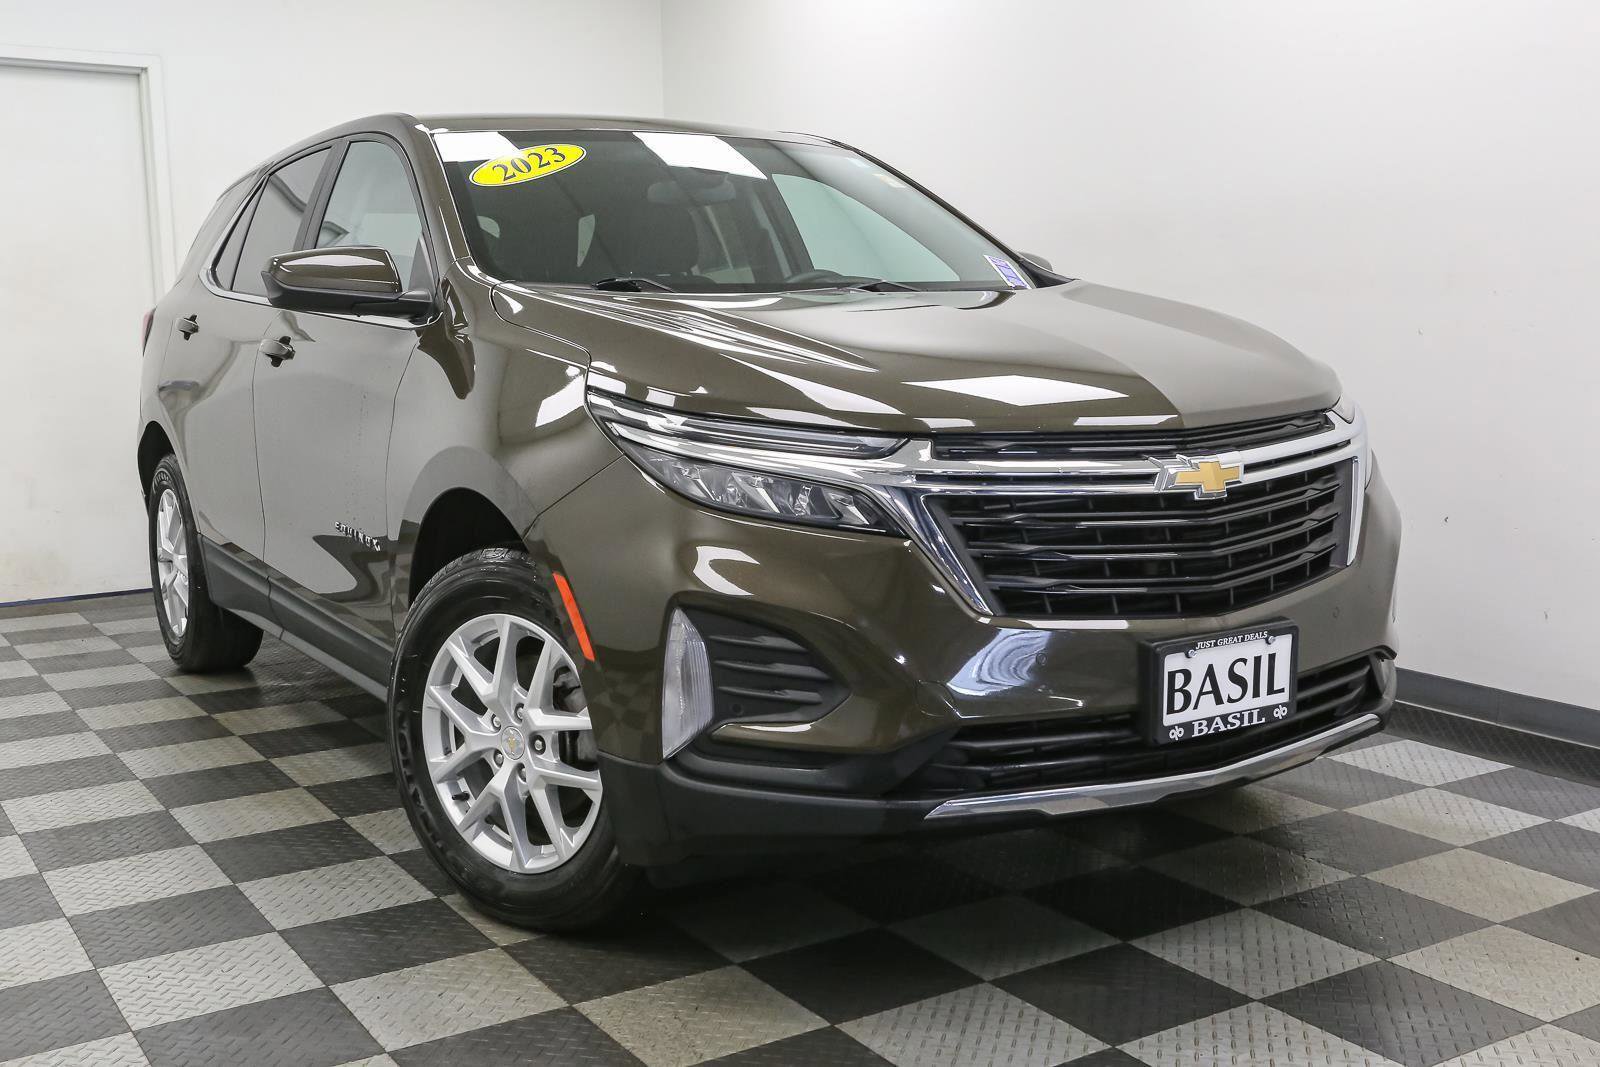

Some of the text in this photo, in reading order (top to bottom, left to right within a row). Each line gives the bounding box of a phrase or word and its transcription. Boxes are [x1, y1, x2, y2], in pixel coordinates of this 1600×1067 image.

[492, 147, 566, 181] 2023
[1195, 631, 1268, 650] JUST GREAT DEALS
[1166, 652, 1286, 715] BASIL
[1191, 708, 1266, 738] BASIL
